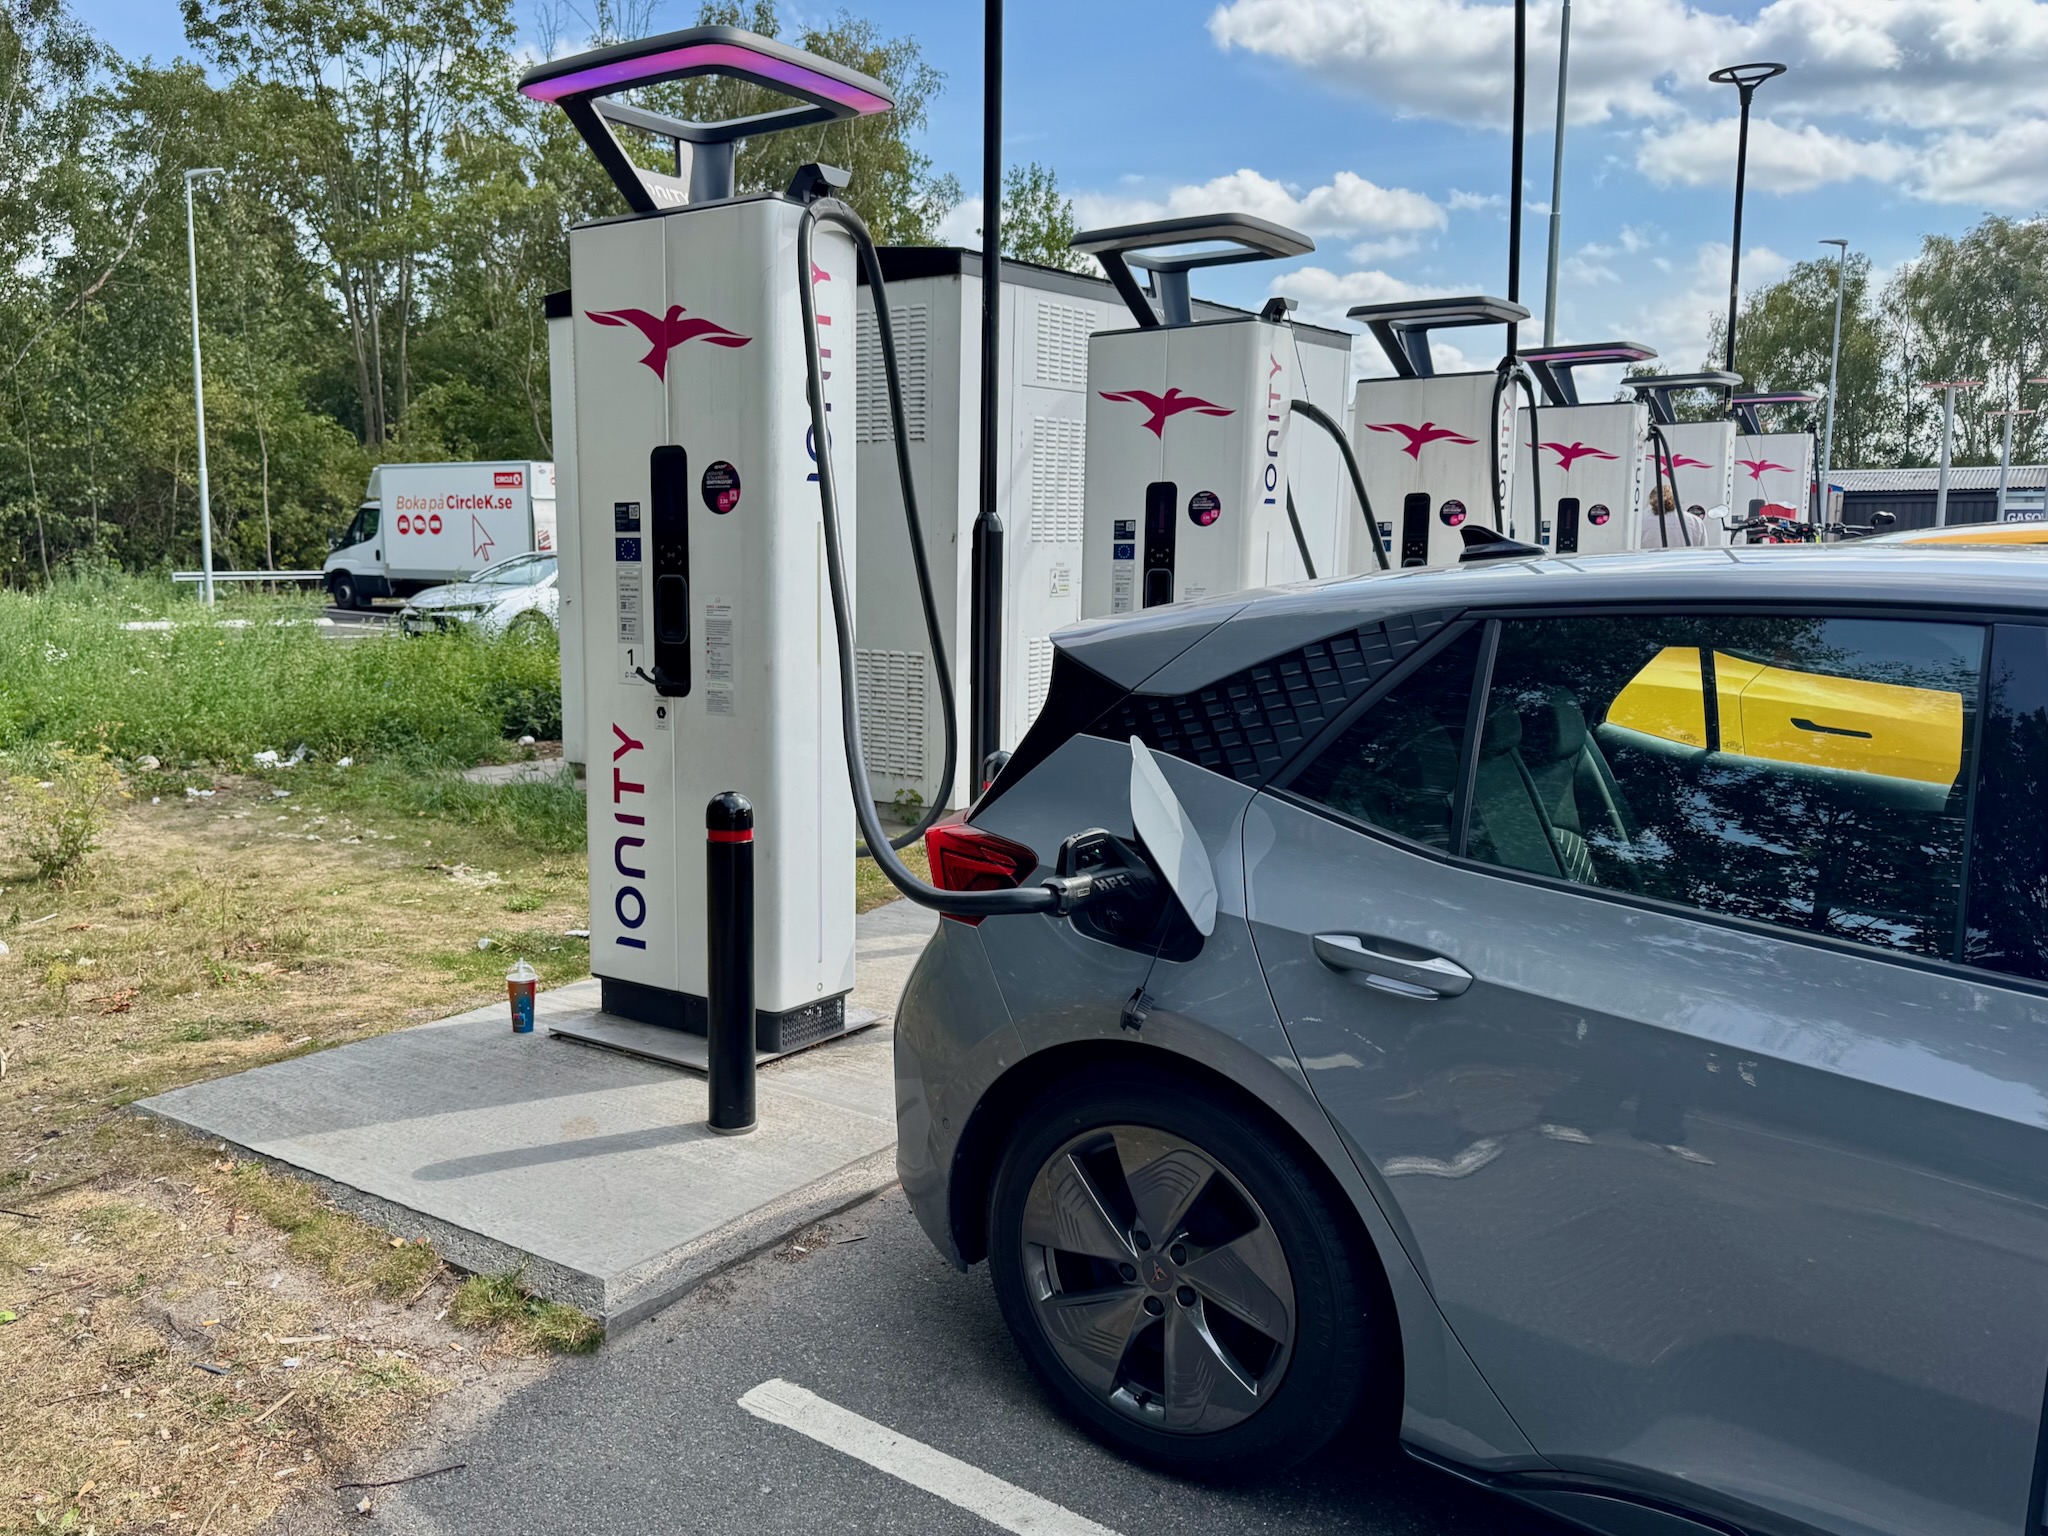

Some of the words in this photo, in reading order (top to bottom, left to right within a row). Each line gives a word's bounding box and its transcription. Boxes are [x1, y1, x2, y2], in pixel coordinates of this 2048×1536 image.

[1264, 352, 1283, 505] IONITY
[397, 495, 427, 510] Boka
[428, 492, 445, 512] på
[446, 494, 513, 509] CircleK.se
[2007, 512, 2044, 522] GASO
[627, 649, 634, 666] 1
[612, 722, 647, 950] IONITY
[1094, 874, 1130, 891] HPC
